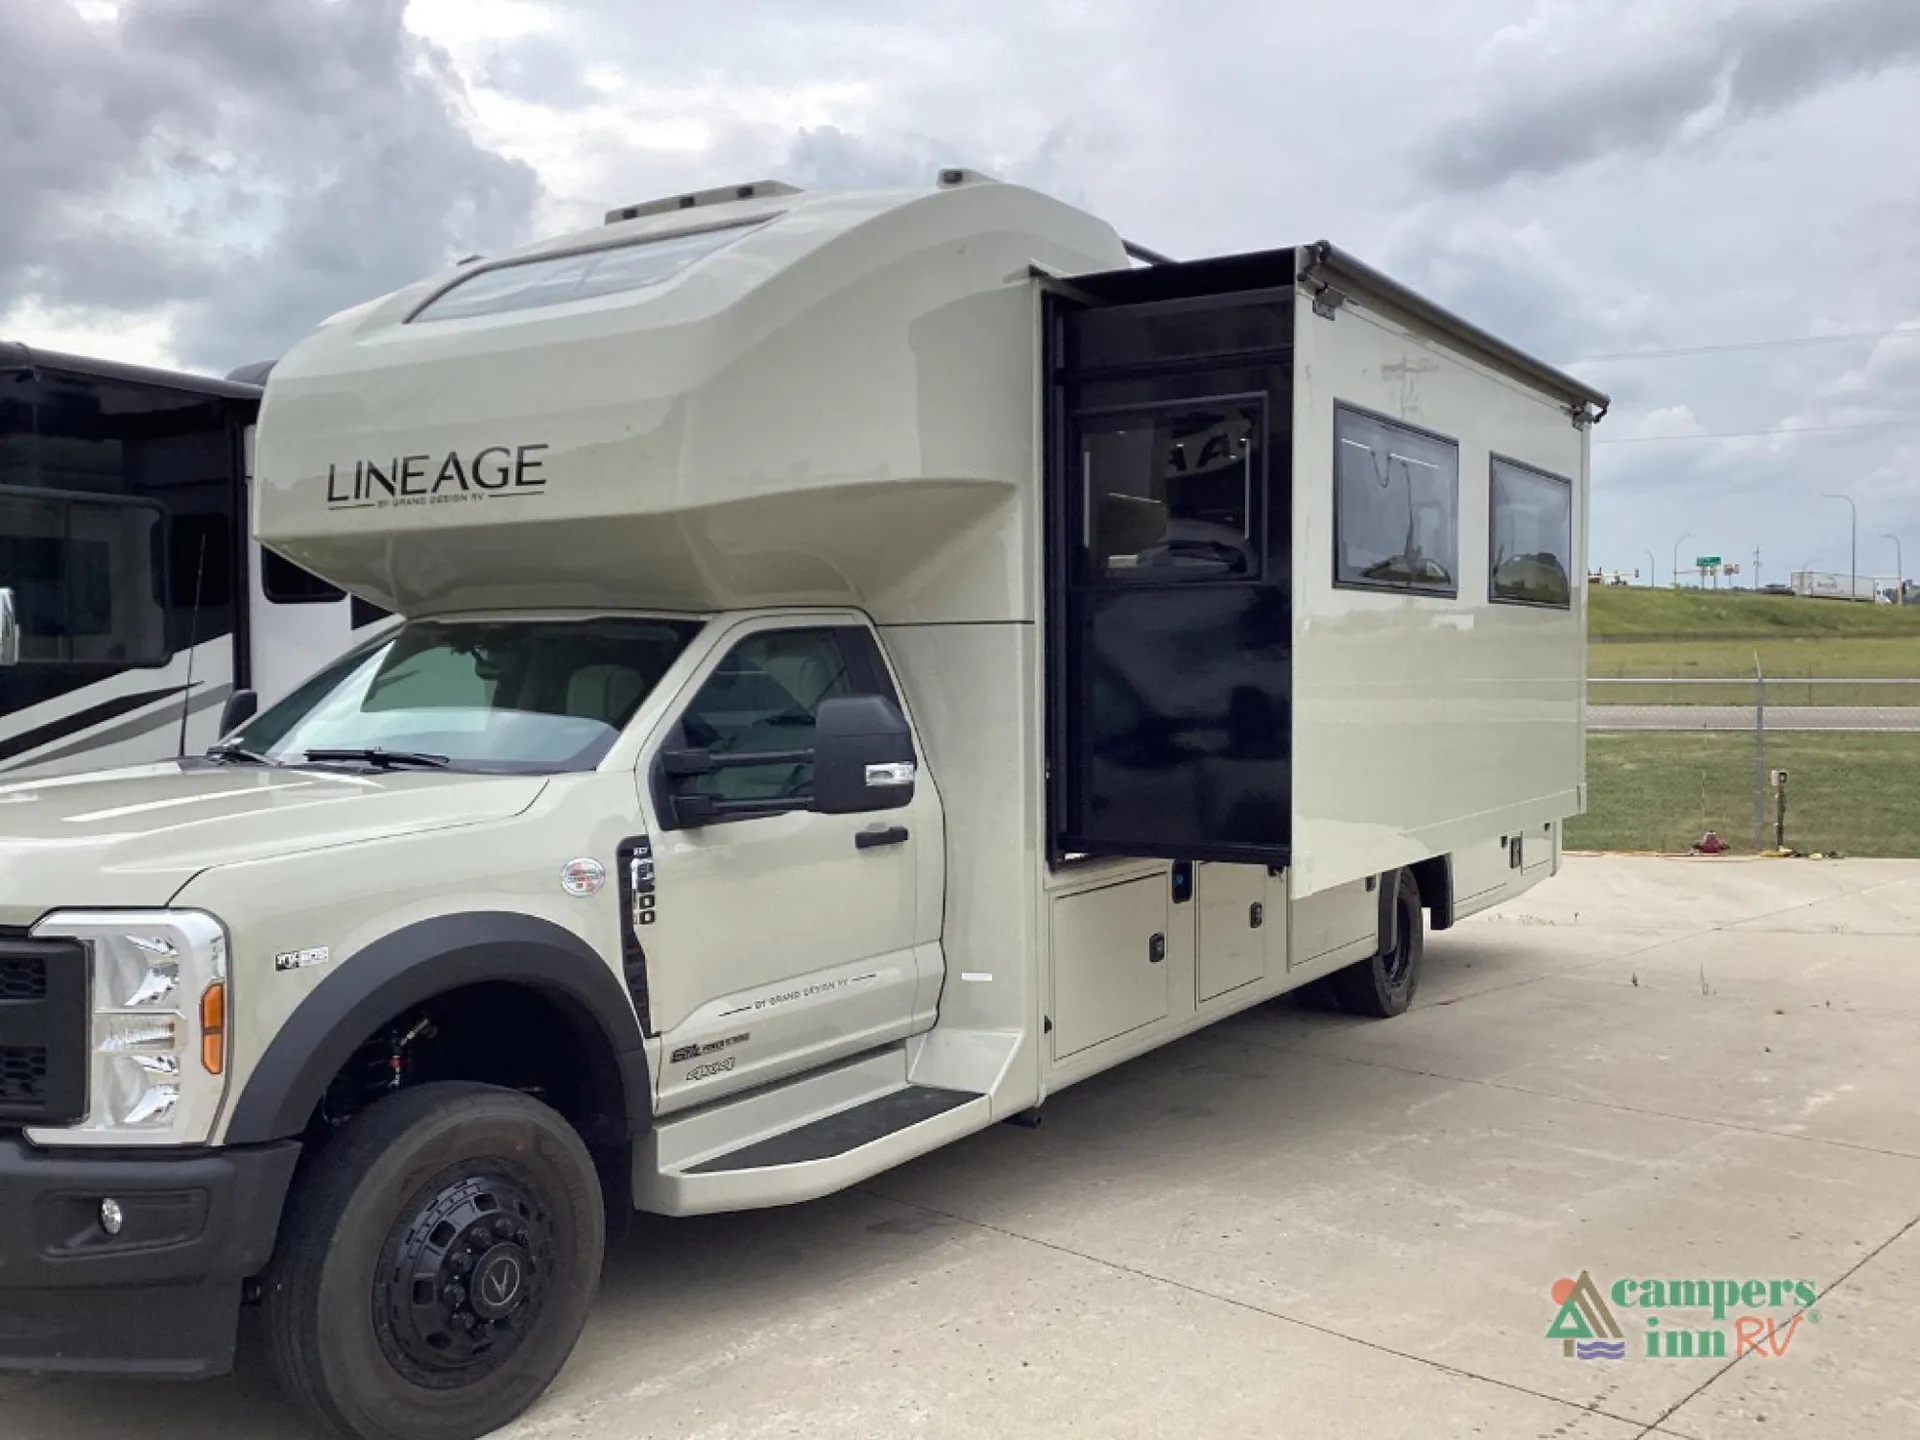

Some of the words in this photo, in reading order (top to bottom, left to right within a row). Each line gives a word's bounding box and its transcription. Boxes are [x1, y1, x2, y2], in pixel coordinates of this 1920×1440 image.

[326, 443, 549, 502] LINEAGE
[392, 496, 427, 507] GRAND
[429, 494, 467, 505] DESIGN
